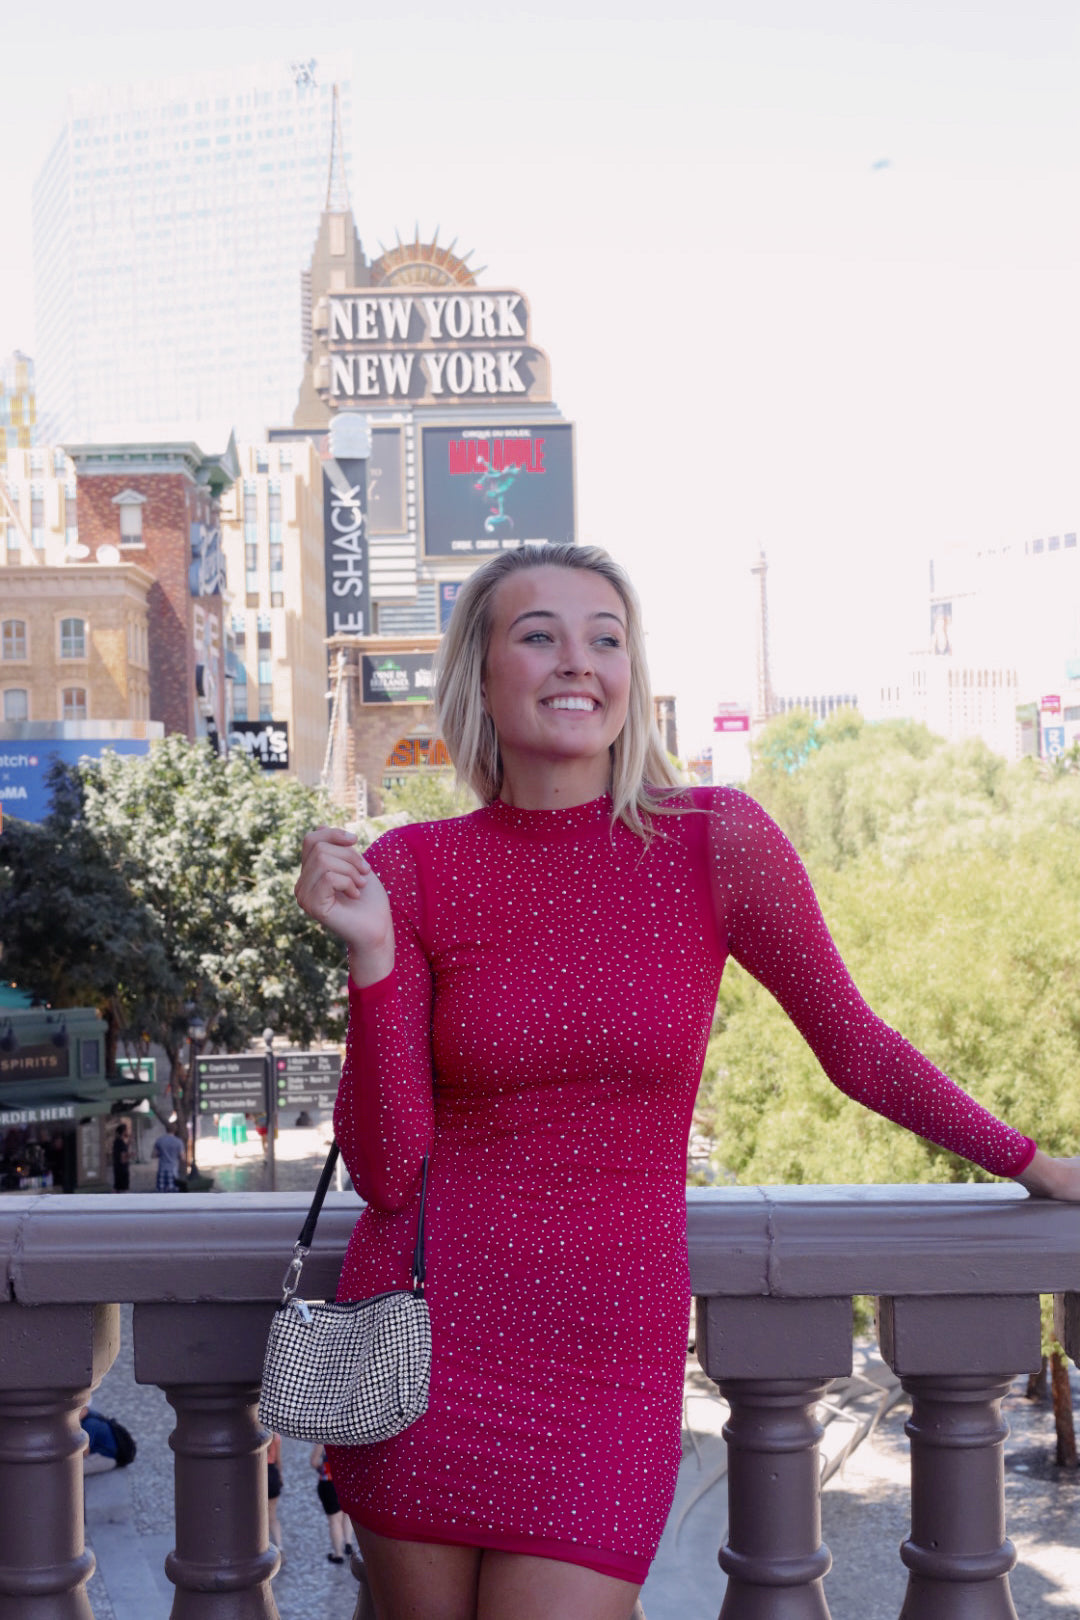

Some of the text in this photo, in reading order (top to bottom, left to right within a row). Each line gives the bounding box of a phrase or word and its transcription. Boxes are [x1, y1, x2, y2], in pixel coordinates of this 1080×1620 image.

[328, 295, 525, 341] NEW YORK
[329, 351, 527, 396] NEW YORK
[330, 484, 363, 598] SHACK
[1, 1055, 58, 1071] SPIRITS
[0, 1106, 75, 1125] RDER HERE
